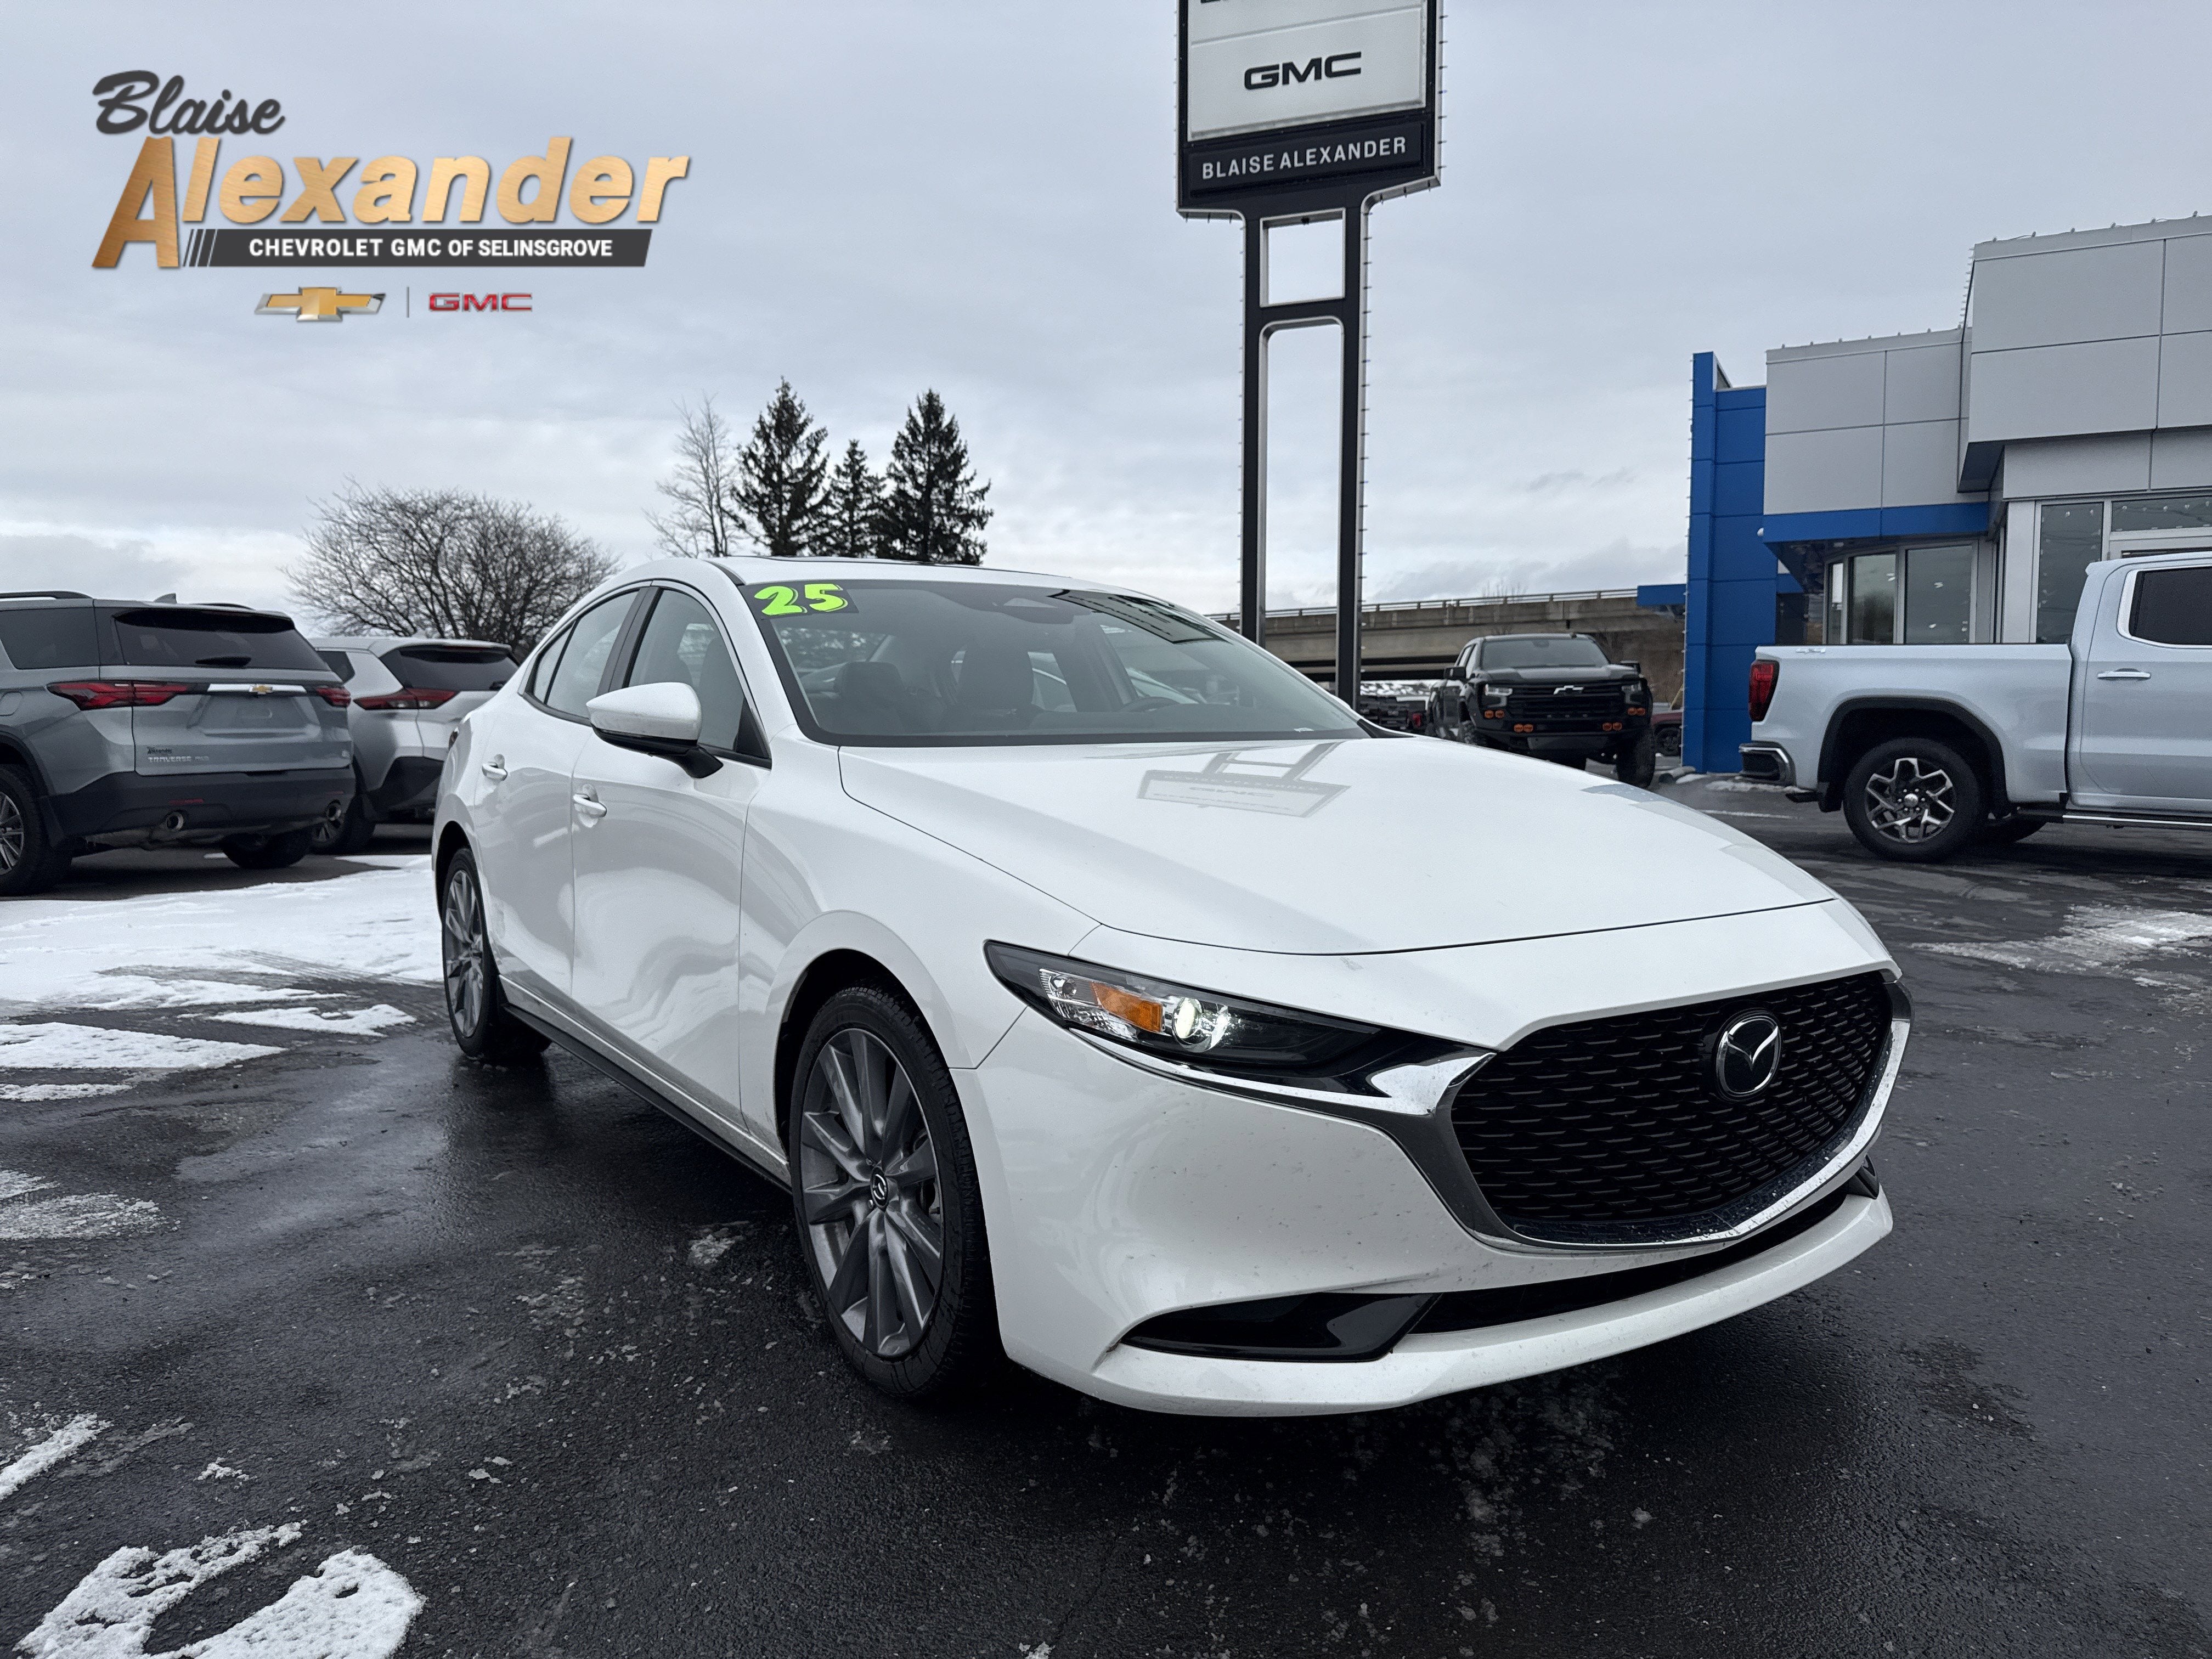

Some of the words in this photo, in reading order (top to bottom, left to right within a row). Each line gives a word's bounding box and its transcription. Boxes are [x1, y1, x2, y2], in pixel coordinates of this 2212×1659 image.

[1244, 51, 1362, 91] GMC
[1202, 154, 1274, 180] BLAISE
[1280, 136, 1406, 169] ALEXANDER
[754, 583, 848, 616] 25
